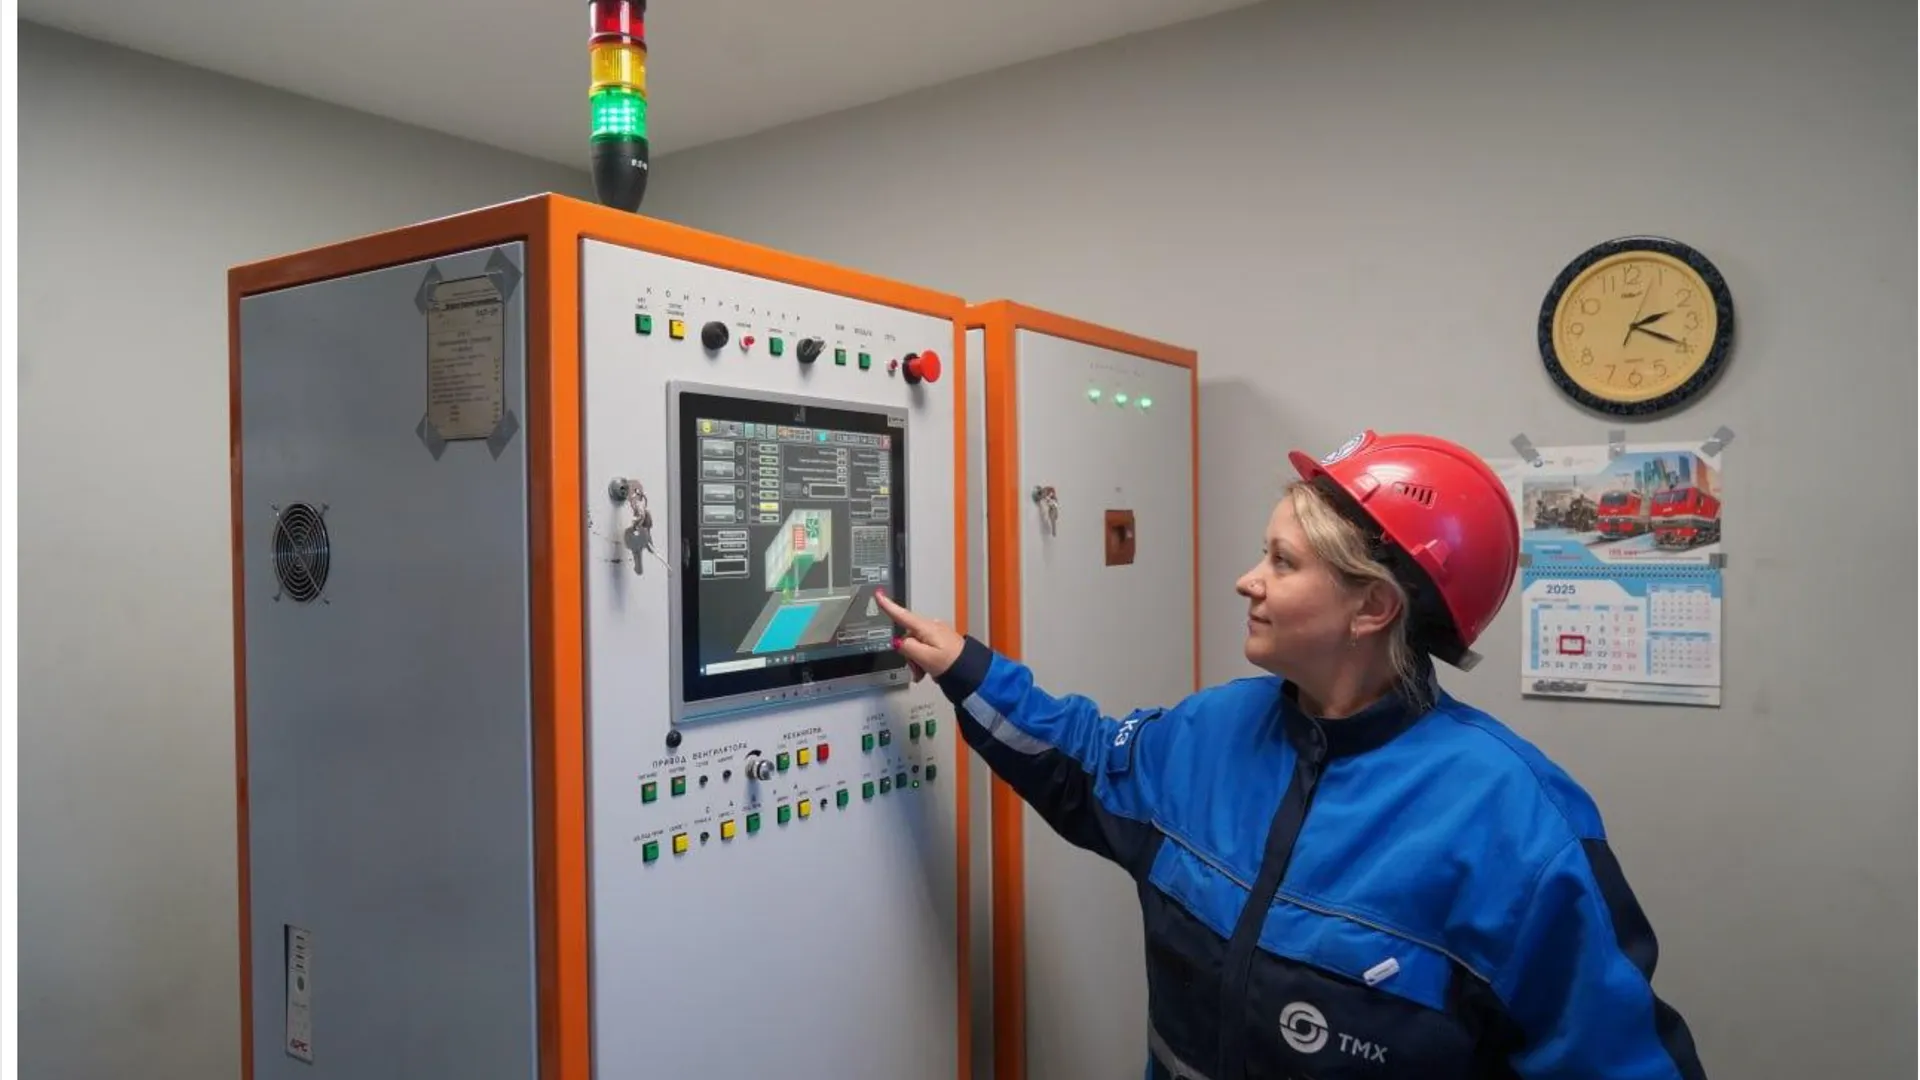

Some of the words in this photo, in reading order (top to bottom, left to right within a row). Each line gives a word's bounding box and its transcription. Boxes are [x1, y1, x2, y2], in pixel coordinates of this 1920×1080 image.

[1622, 264, 1641, 285] 12
[1658, 268, 1663, 287] 1
[1602, 275, 1615, 295] 11
[1580, 298, 1601, 316] 10
[1675, 288, 1692, 308] 2
[1570, 322, 1585, 340] 9
[1684, 311, 1699, 331] 3
[1675, 337, 1688, 354] 4
[1581, 346, 1594, 366] 8
[1604, 364, 1616, 384] 7
[1628, 368, 1643, 387] 6
[1653, 359, 1667, 379] 5
[1546, 583, 1576, 595] 2025
[652, 756, 687, 768] ПРИВОД
[692, 742, 747, 760] ВЕНТИЛЯТОРА
